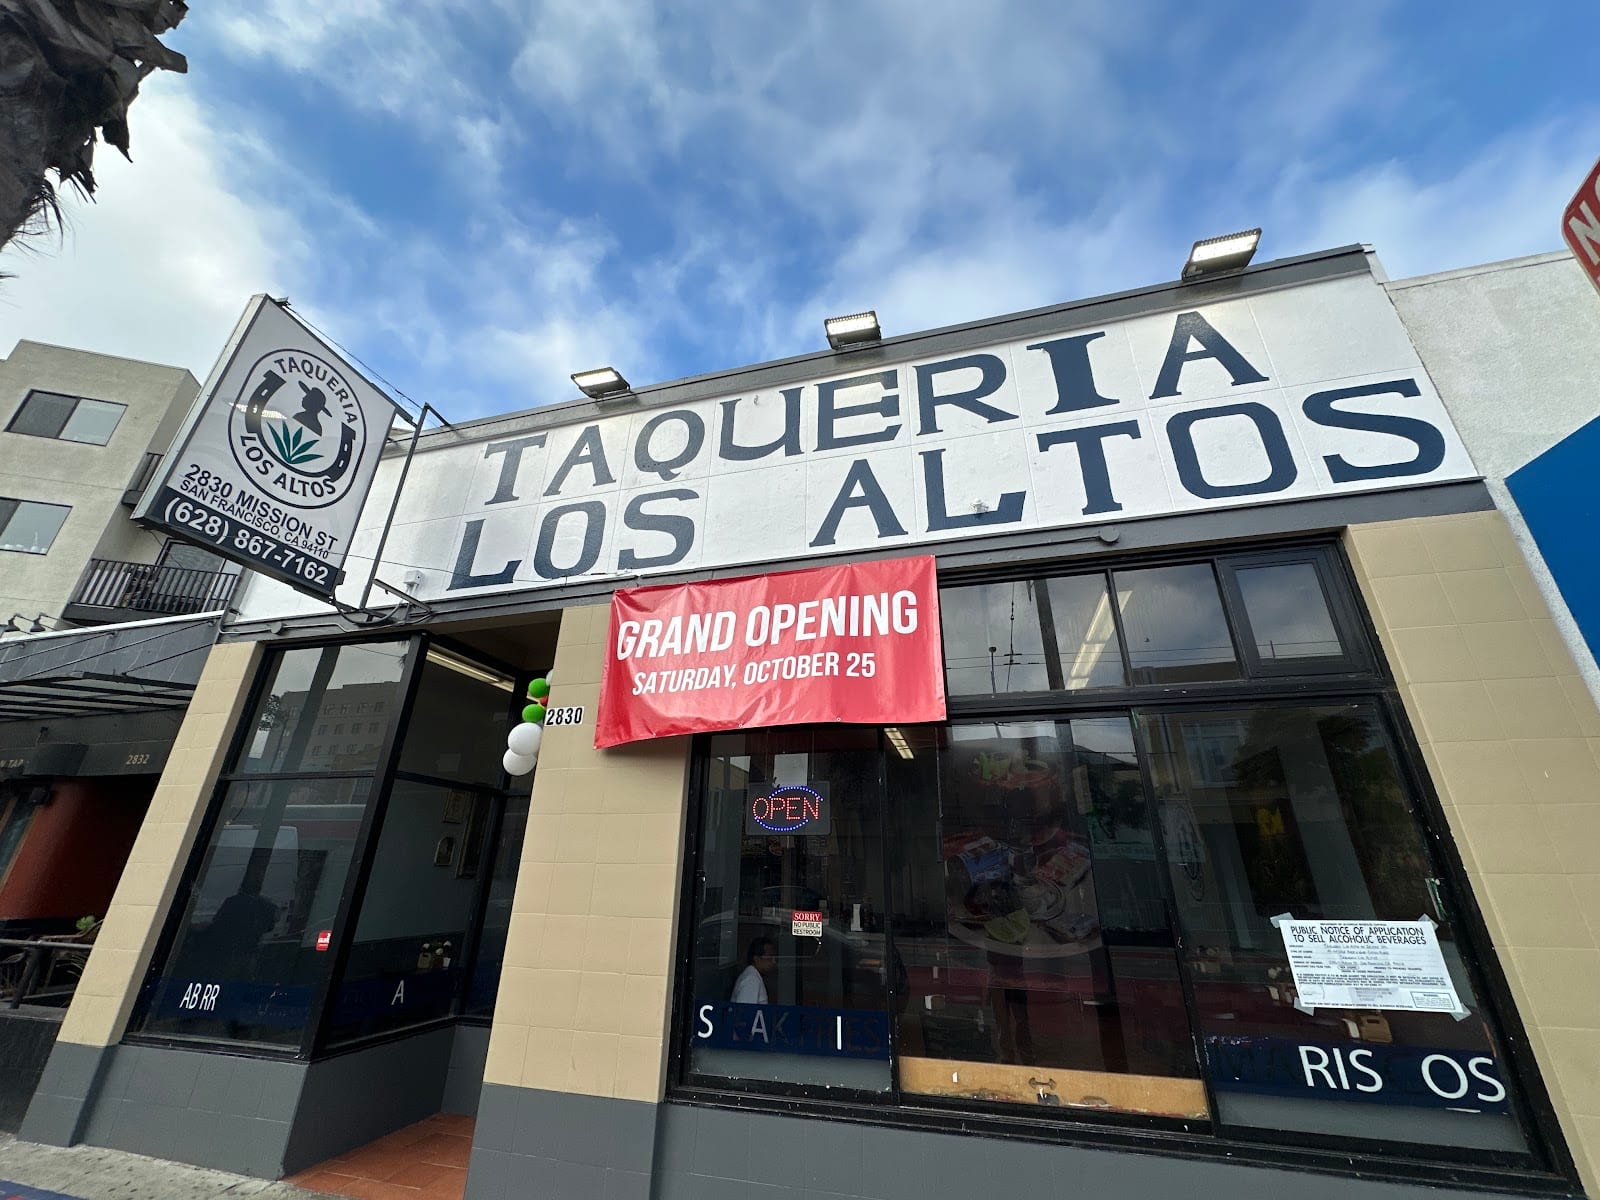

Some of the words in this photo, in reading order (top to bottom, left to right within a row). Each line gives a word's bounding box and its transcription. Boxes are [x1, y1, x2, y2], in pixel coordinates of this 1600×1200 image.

[273, 356, 358, 424] TAQUERIA
[485, 311, 1269, 506] TAQUERIA
[240, 435, 275, 475] LOS
[273, 473, 336, 498] ALTOS
[446, 488, 700, 591] LOS
[808, 377, 1446, 547] ALTOS
[180, 479, 210, 501] SAN
[210, 496, 281, 538] FRANCISCO,
[284, 532, 299, 547] CA
[301, 540, 329, 559] 94110
[184, 463, 233, 498] 2830
[235, 490, 313, 539] MISSION
[315, 531, 338, 550] ST
[164, 497, 230, 544] (628)
[233, 529, 329, 585] 867-7162
[616, 610, 736, 661] GRAND
[745, 590, 918, 648] OPENING
[632, 663, 737, 695] SATURDAY,
[743, 652, 839, 686] OCTOBER
[846, 652, 876, 678] 25
[546, 709, 583, 726] 2830
[125, 754, 150, 765] 2832
[753, 797, 819, 820] OPEN
[793, 912, 821, 921] SORRY
[1290, 926, 1318, 935] PUBLIC
[1321, 926, 1350, 935] NOTICE
[1353, 926, 1365, 935] OF
[1369, 926, 1424, 936] APPLICATION
[1293, 934, 1305, 943] TO
[1309, 935, 1326, 943] SELL
[1329, 935, 1374, 944] ALCOHOLIC
[1377, 936, 1427, 945] BEVERAGES
